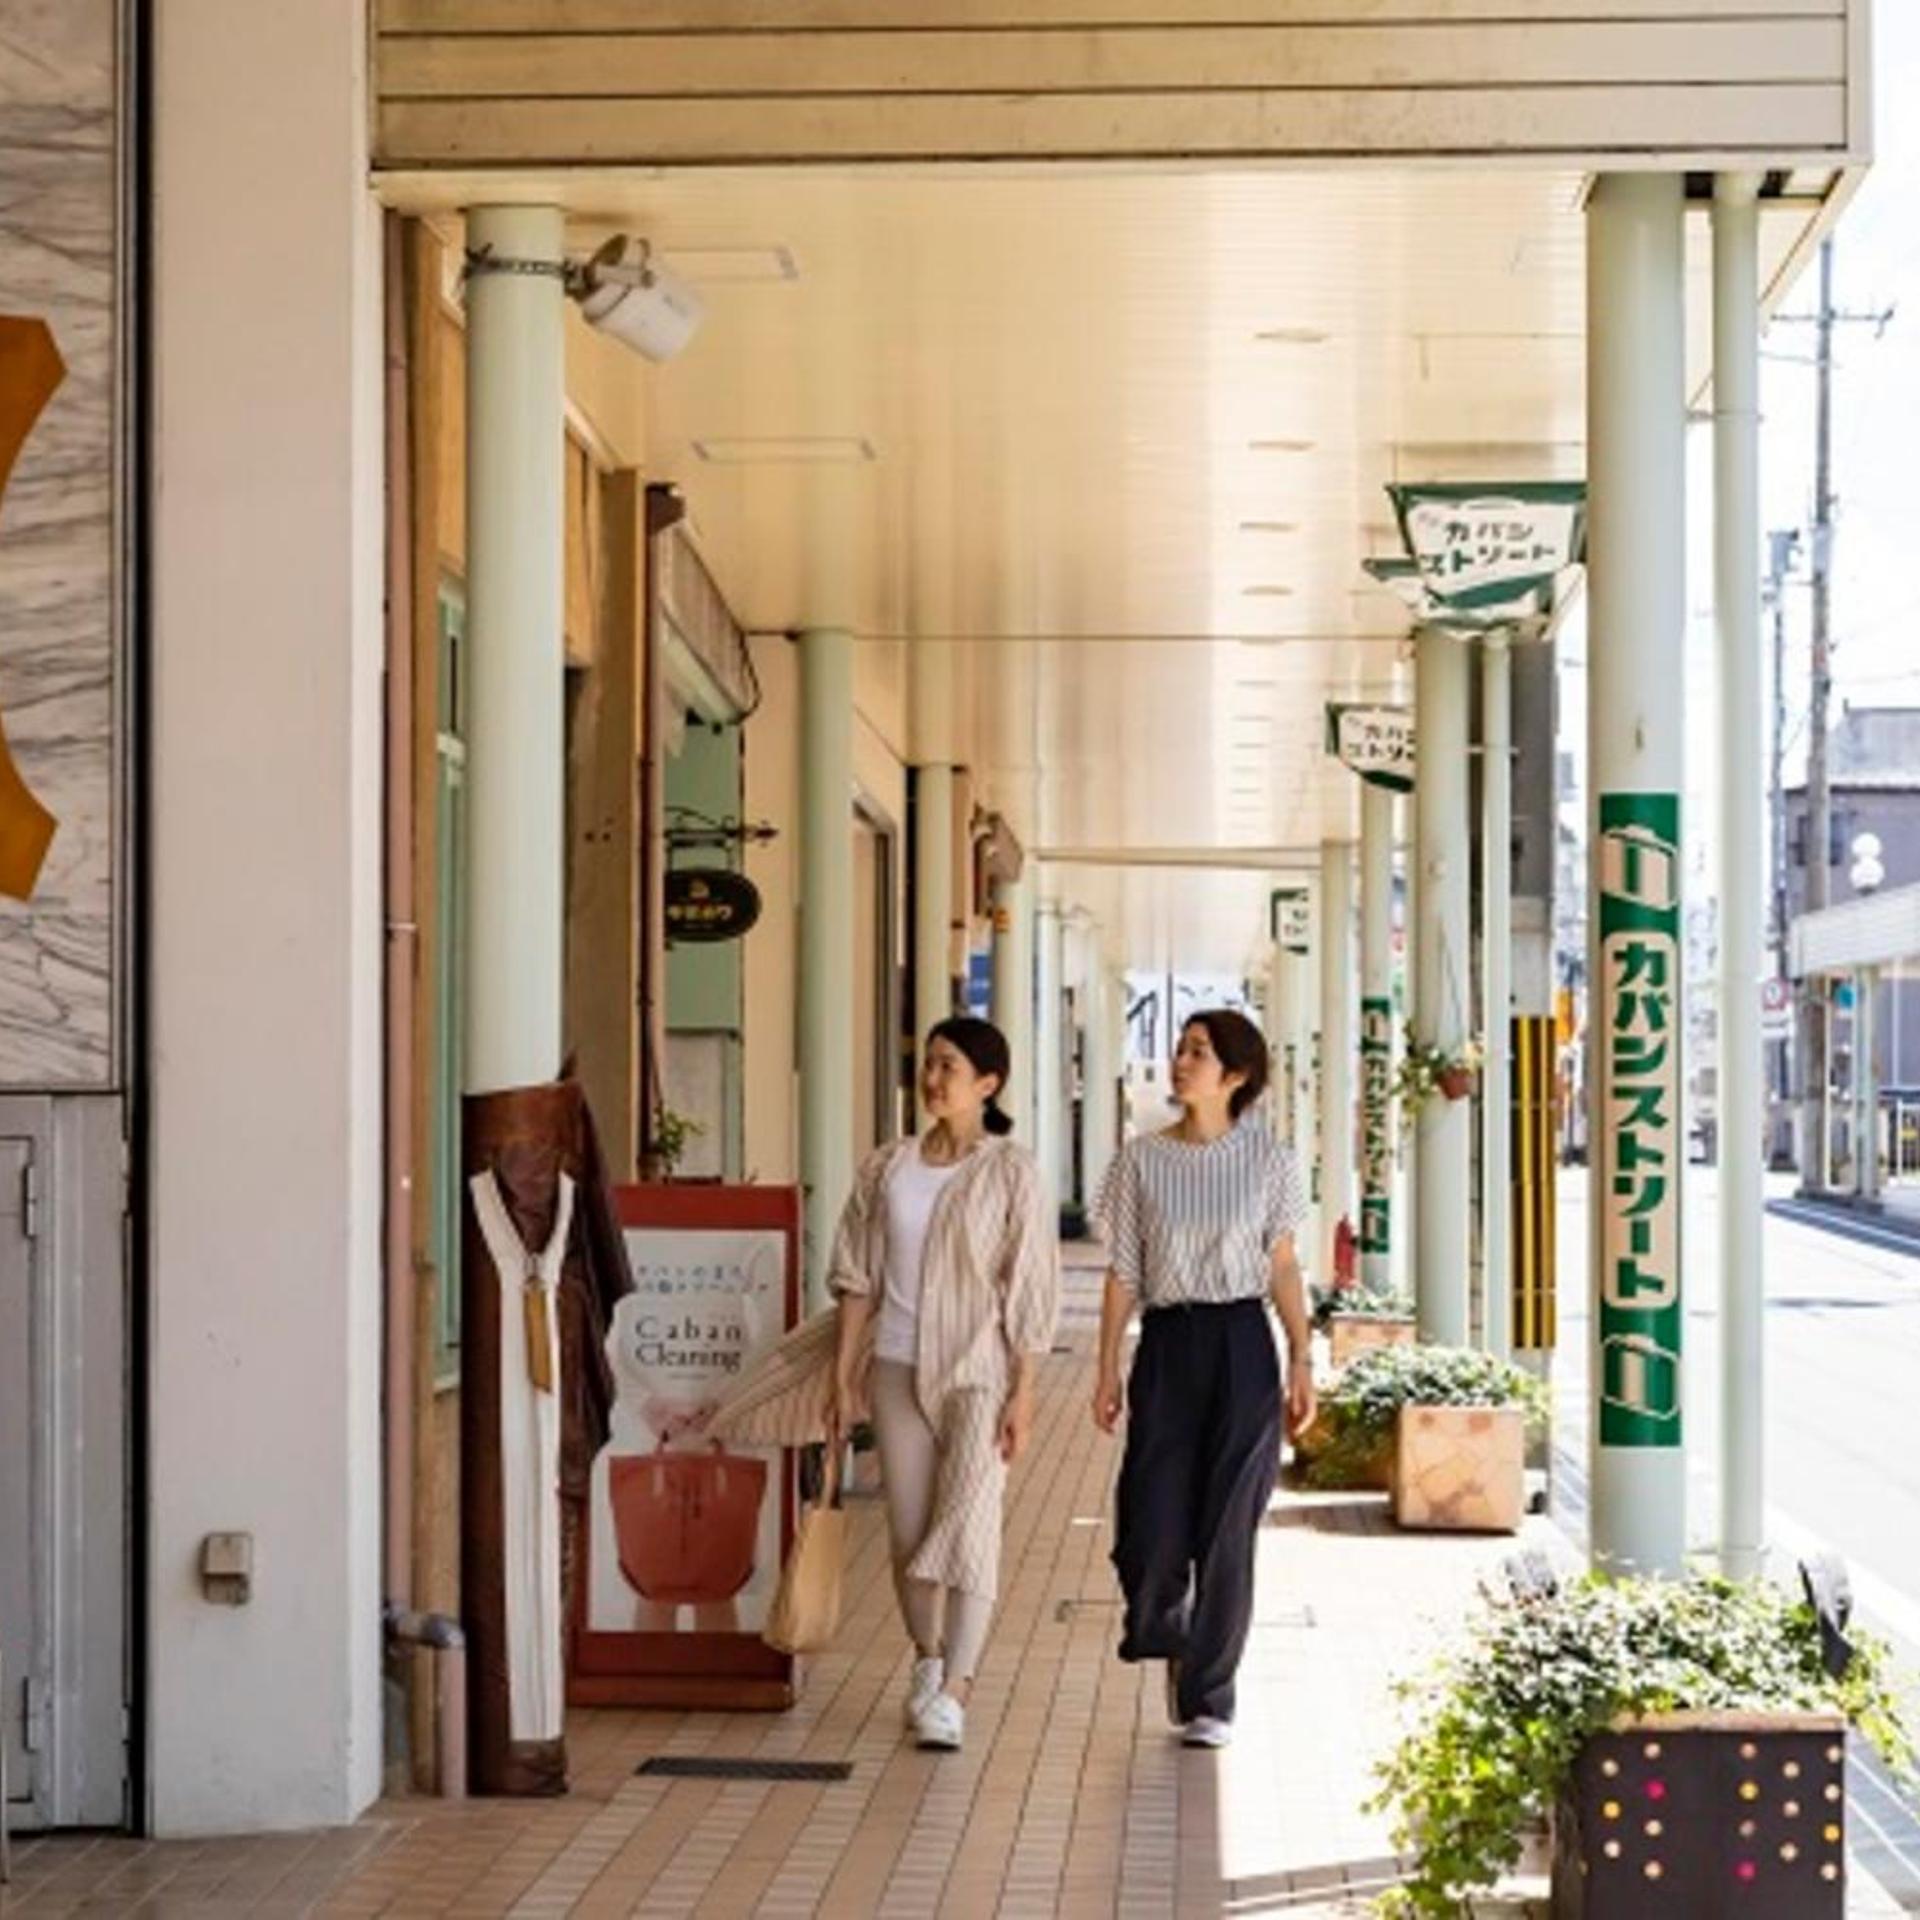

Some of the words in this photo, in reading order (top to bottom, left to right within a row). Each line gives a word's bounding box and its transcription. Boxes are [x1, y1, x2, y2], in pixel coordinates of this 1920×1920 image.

[1612, 942, 1670, 1299] カバンストリート
[635, 1316, 741, 1340] Caban
[635, 1343, 741, 1373] Cleaning
